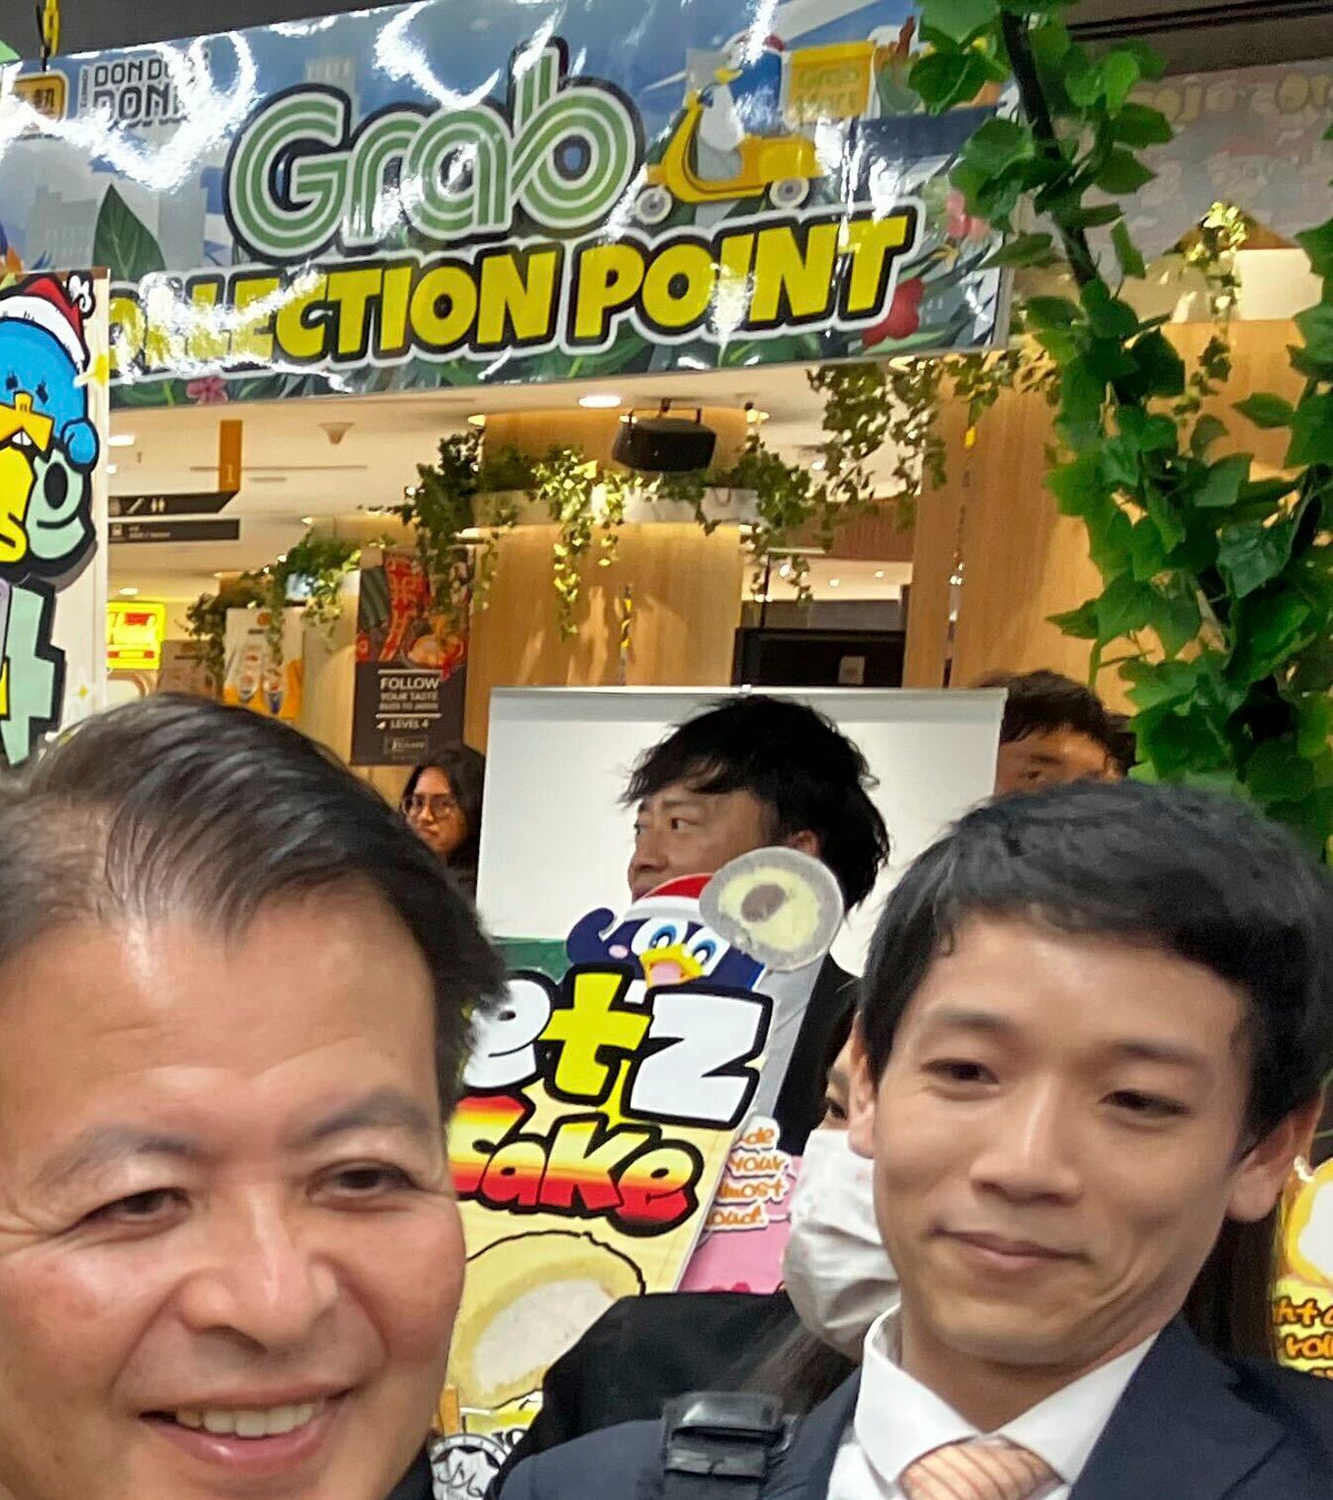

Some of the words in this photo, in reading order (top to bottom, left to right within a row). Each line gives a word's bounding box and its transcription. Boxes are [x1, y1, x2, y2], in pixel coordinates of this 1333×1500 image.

[233, 42, 635, 257] Grab
[573, 213, 913, 339] POINT
[379, 676, 440, 690] FOLLOW
[389, 719, 420, 729] LEVEL
